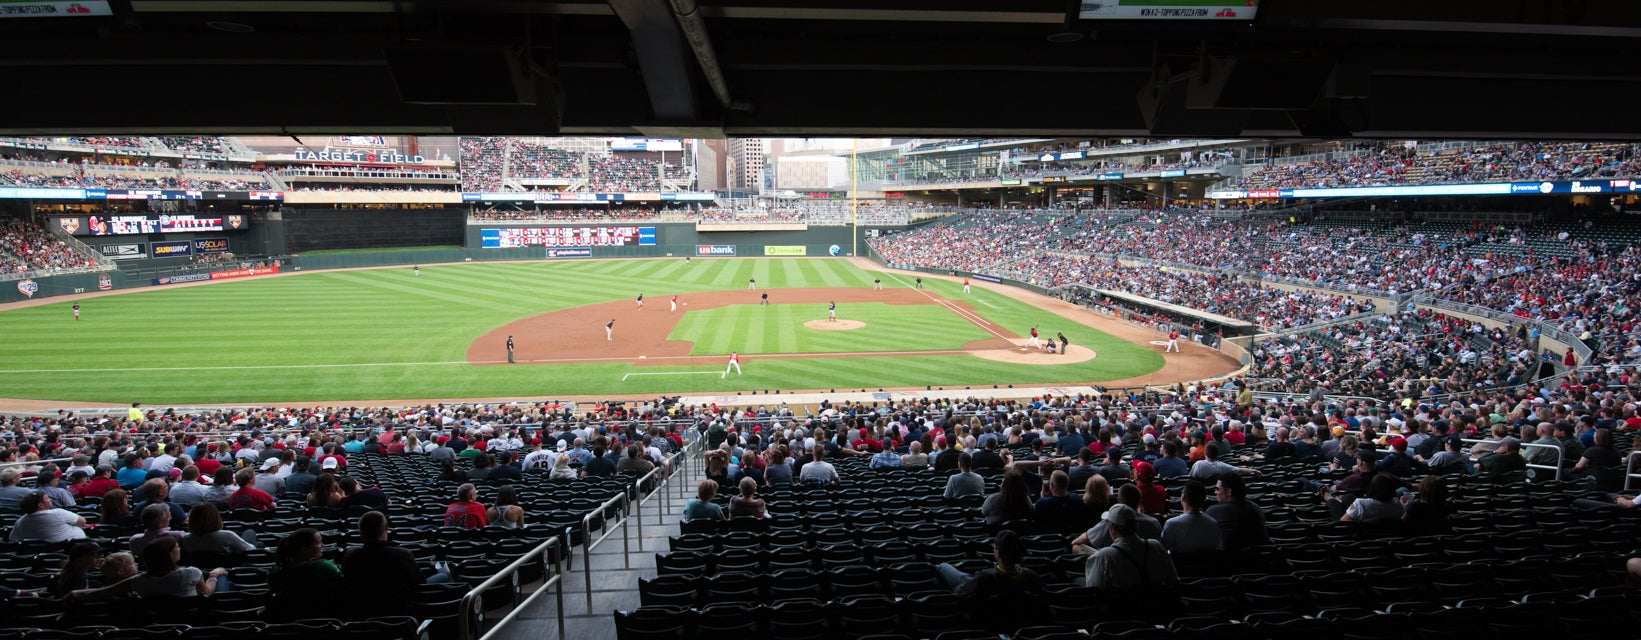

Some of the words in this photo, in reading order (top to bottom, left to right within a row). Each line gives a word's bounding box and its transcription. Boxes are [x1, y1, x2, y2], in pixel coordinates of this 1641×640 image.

[295, 151, 363, 161] TARGET
[381, 154, 424, 164] FIELD
[155, 245, 188, 254] SUBWAY
[26, 283, 37, 291] 29
